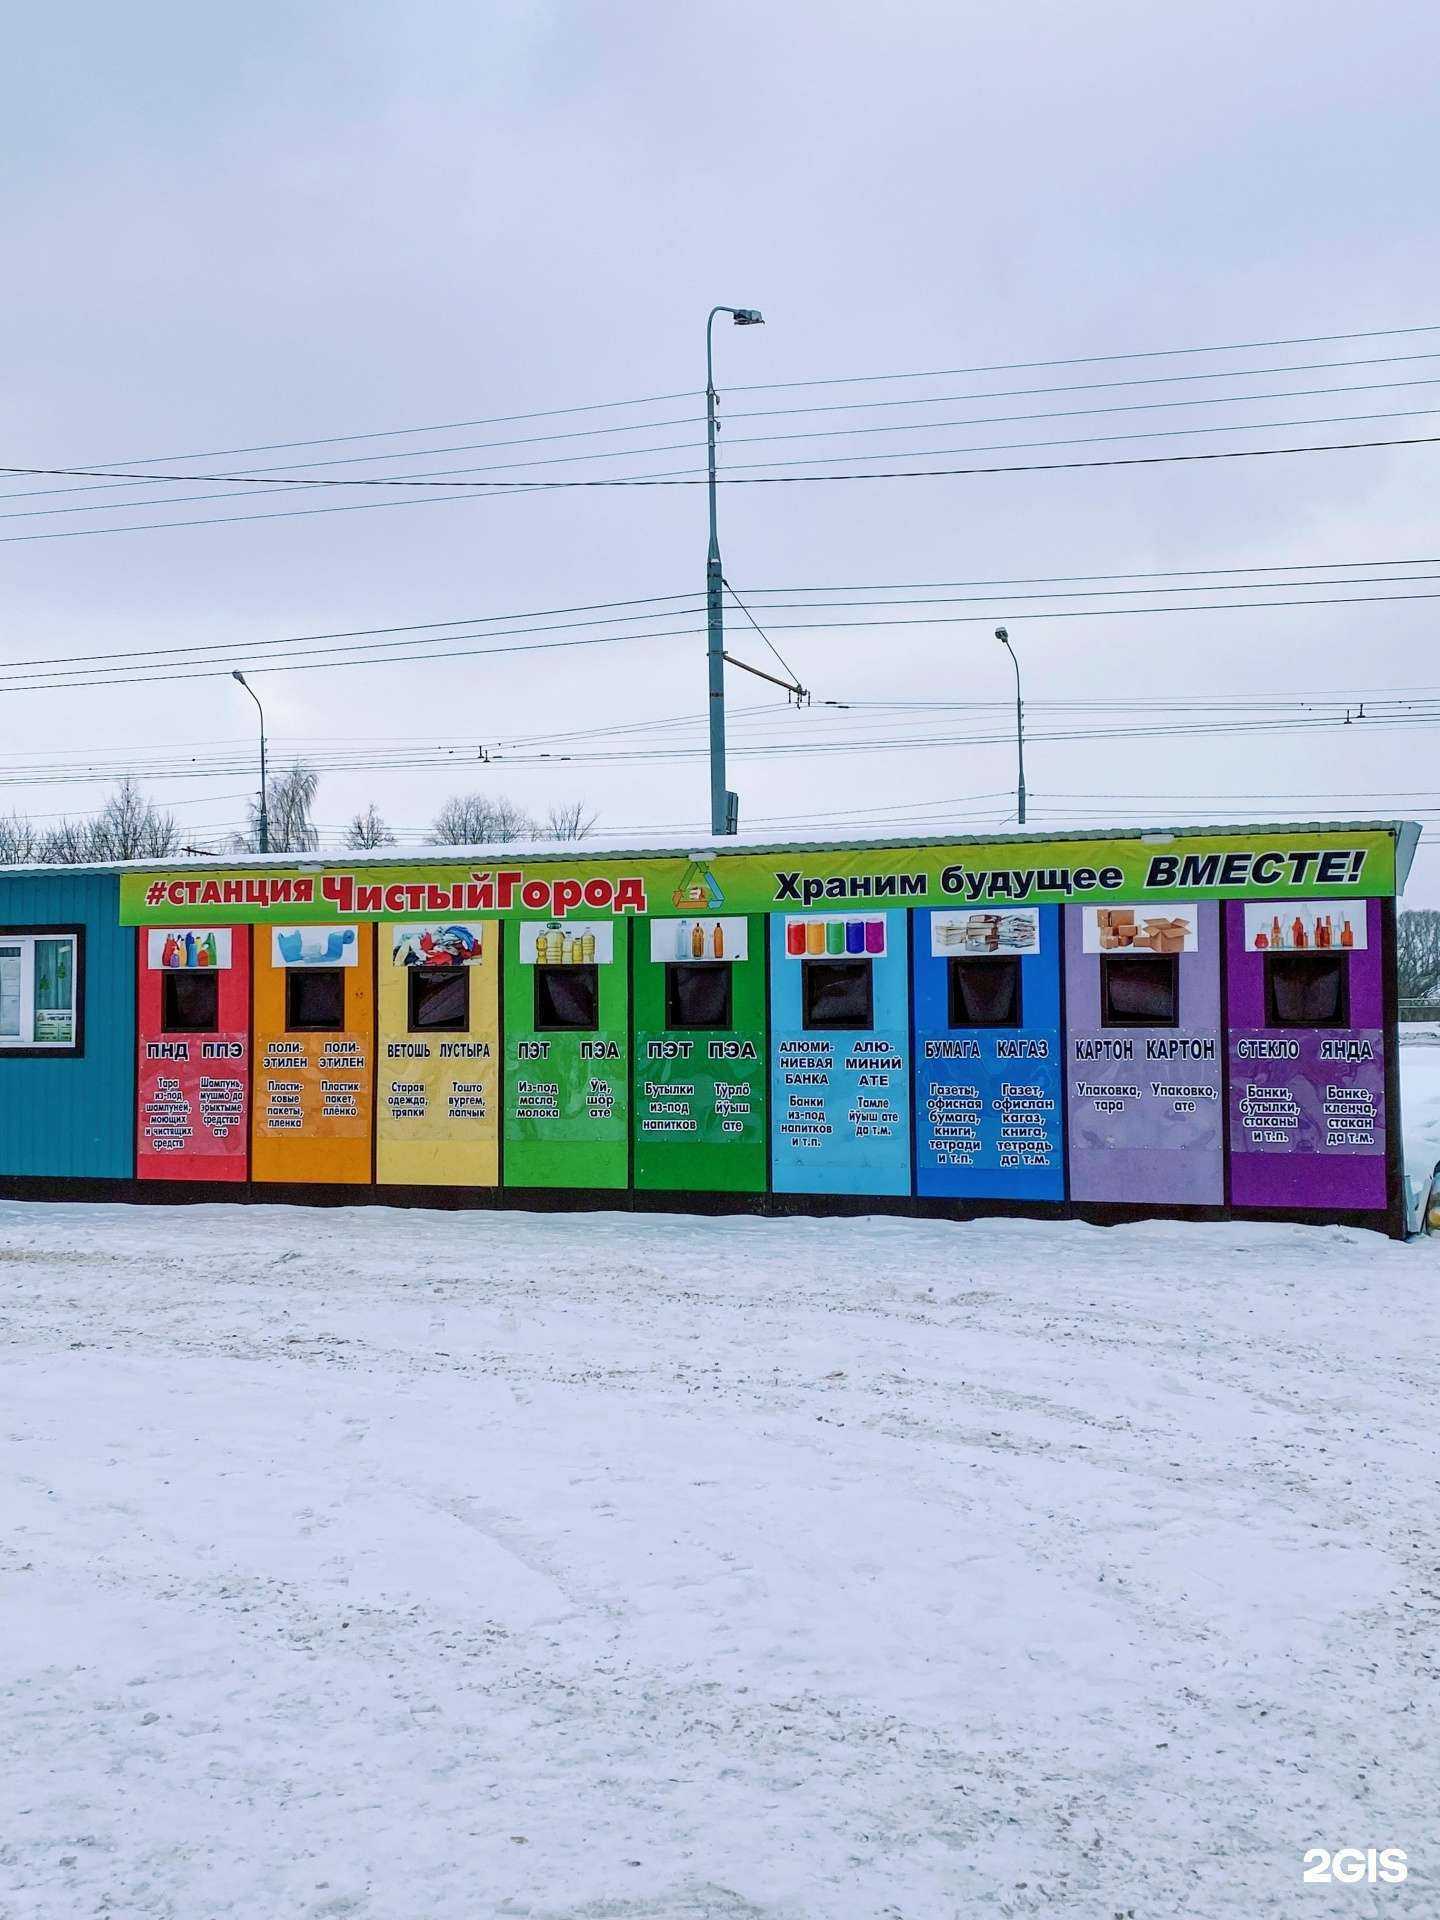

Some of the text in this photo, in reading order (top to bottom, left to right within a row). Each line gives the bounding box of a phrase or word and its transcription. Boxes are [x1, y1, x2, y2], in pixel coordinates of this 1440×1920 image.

[774, 849, 1367, 905] Храним будущее ВМЕСТЕ!
[145, 871, 648, 917] #СТАНЦИЯ ЧистыйГород
[147, 1042, 189, 1061] ПНД
[202, 1042, 243, 1058] ППЭ
[268, 1043, 303, 1053] ПОЛИ-
[324, 1043, 360, 1053] ПОЛИ-
[387, 1043, 431, 1058] ВЕТОШЬ
[440, 1043, 490, 1058] ЛУСТЫРА
[518, 1043, 551, 1059] ПЭТ
[581, 1042, 620, 1059] ПЭА
[648, 1042, 693, 1059] ПЭТ
[708, 1042, 756, 1059] ПЭА
[780, 1042, 834, 1053] АЛЮМИ-
[853, 1042, 894, 1052] АЛЮ-
[925, 1041, 981, 1058] БУМАГА
[997, 1040, 1049, 1058] КАГАЗ
[1076, 1041, 1133, 1060] КАРТОН
[1147, 1039, 1215, 1060] КАРТОН
[1238, 1041, 1298, 1059] СТЕКЛО
[1321, 1041, 1373, 1061] ЯНДА
[264, 1057, 308, 1068] ЭТИЛЕН
[319, 1057, 364, 1068] ЭТИЛЕН
[780, 1058, 833, 1069] НИЕВАЯ
[845, 1057, 902, 1069] МИНИЙ
[158, 1078, 178, 1091] Тара
[200, 1078, 243, 1091] Шампунь,
[785, 1074, 828, 1084] БАНКА
[859, 1075, 889, 1086] АТЕ
[268, 1081, 303, 1091] Пласти-
[321, 1081, 359, 1091] Пластик
[392, 1082, 424, 1095] Старая
[452, 1082, 483, 1092] Тошто
[518, 1082, 558, 1094] Из-под
[645, 1083, 694, 1096] Бутылки
[930, 1084, 979, 1098] Газеты,
[1002, 1084, 1044, 1098] Газет,
[1077, 1083, 1142, 1098] Упаковка,
[1152, 1084, 1218, 1098] Упаковко,
[155, 1091, 182, 1101] из-под
[1247, 1086, 1293, 1100] Банки,
[1328, 1087, 1373, 1101] Банке,
[271, 1095, 299, 1104] ковые
[325, 1095, 355, 1105] пакет,
[388, 1095, 428, 1106] одежда,
[448, 1095, 486, 1107] вургем,
[519, 1095, 557, 1107] масла,
[789, 1096, 824, 1107] Банки
[857, 1097, 889, 1109] Тамле
[927, 1100, 982, 1110] офисная
[146, 1101, 192, 1115] шампуней,
[650, 1102, 688, 1115] из-под
[993, 1100, 1053, 1112] офислан
[1095, 1101, 1123, 1113] тара
[1174, 1101, 1195, 1111] ате
[1240, 1100, 1300, 1116] бутылки,
[1324, 1104, 1377, 1116] кленча,
[268, 1107, 303, 1117] пакеты,
[392, 1108, 425, 1119] тряпки
[448, 1108, 486, 1118] лапчык
[517, 1108, 559, 1118] молока
[590, 1108, 611, 1118] ате
[788, 1111, 825, 1122] из-под
[881, 1112, 899, 1122] ате
[150, 1116, 186, 1126] моющих
[203, 1116, 239, 1126] средства
[929, 1112, 981, 1125] бумага,
[1002, 1114, 1045, 1125] кагаз,
[1244, 1117, 1298, 1127] стаканы
[1328, 1118, 1373, 1128] стакан
[643, 1120, 697, 1130] напитков
[723, 1120, 743, 1131] ате
[781, 1124, 832, 1134] напитков
[153, 1128, 192, 1138] чистящих
[214, 1128, 228, 1136] ате
[856, 1126, 869, 1136] да
[935, 1127, 976, 1138] книги,
[1002, 1127, 1046, 1138] книга,
[792, 1138, 821, 1147] и т.п.
[1253, 1132, 1288, 1142] и т.п.
[1327, 1133, 1373, 1144] да т.м.
[153, 1140, 184, 1150] средств
[930, 1141, 981, 1151] тетради
[997, 1141, 1052, 1153] тетрадь
[938, 1155, 973, 1164] и т.п.
[1001, 1155, 1049, 1167] да т.м.
